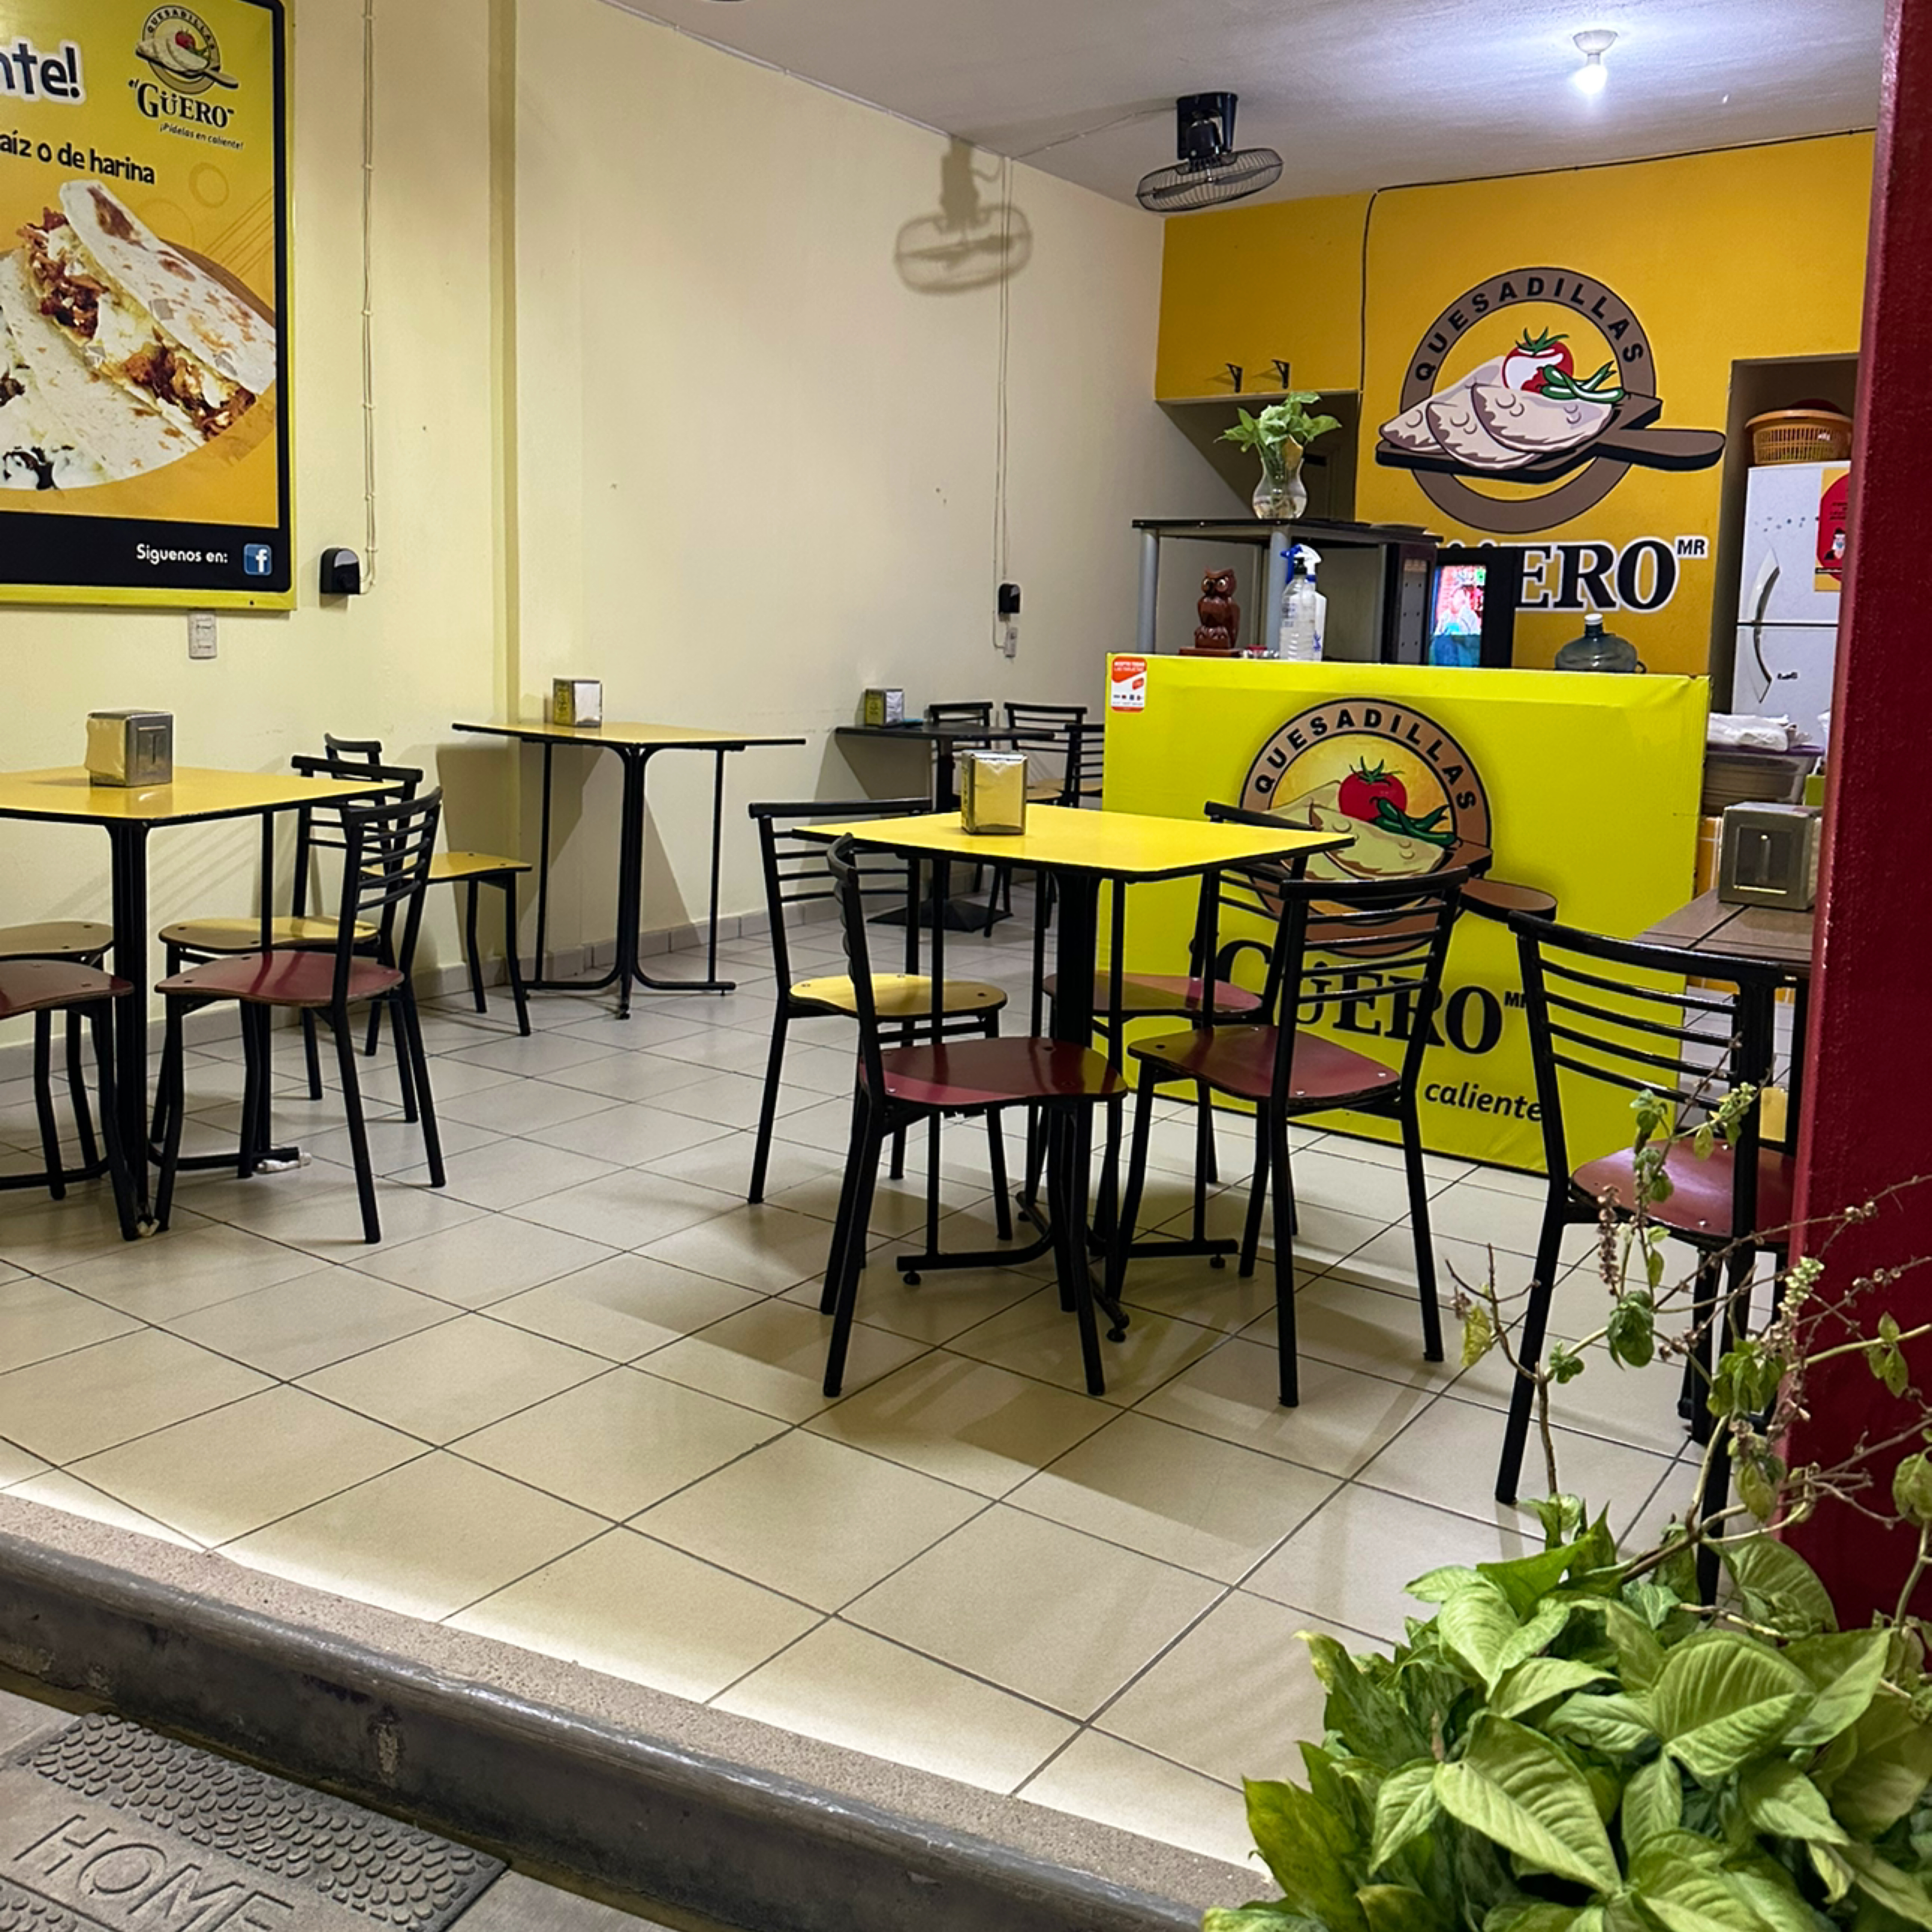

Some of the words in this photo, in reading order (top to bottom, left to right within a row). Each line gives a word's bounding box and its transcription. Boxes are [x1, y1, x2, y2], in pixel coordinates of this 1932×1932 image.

[137, 83, 228, 128] GÜERO
[37, 143, 51, 163] o
[57, 142, 85, 170] de
[90, 148, 155, 185] harina
[1415, 277, 1644, 381] QUESADILLAS
[206, 552, 228, 563] en:
[1676, 539, 1705, 555] MR
[1254, 708, 1476, 810] QUESADILLAS
